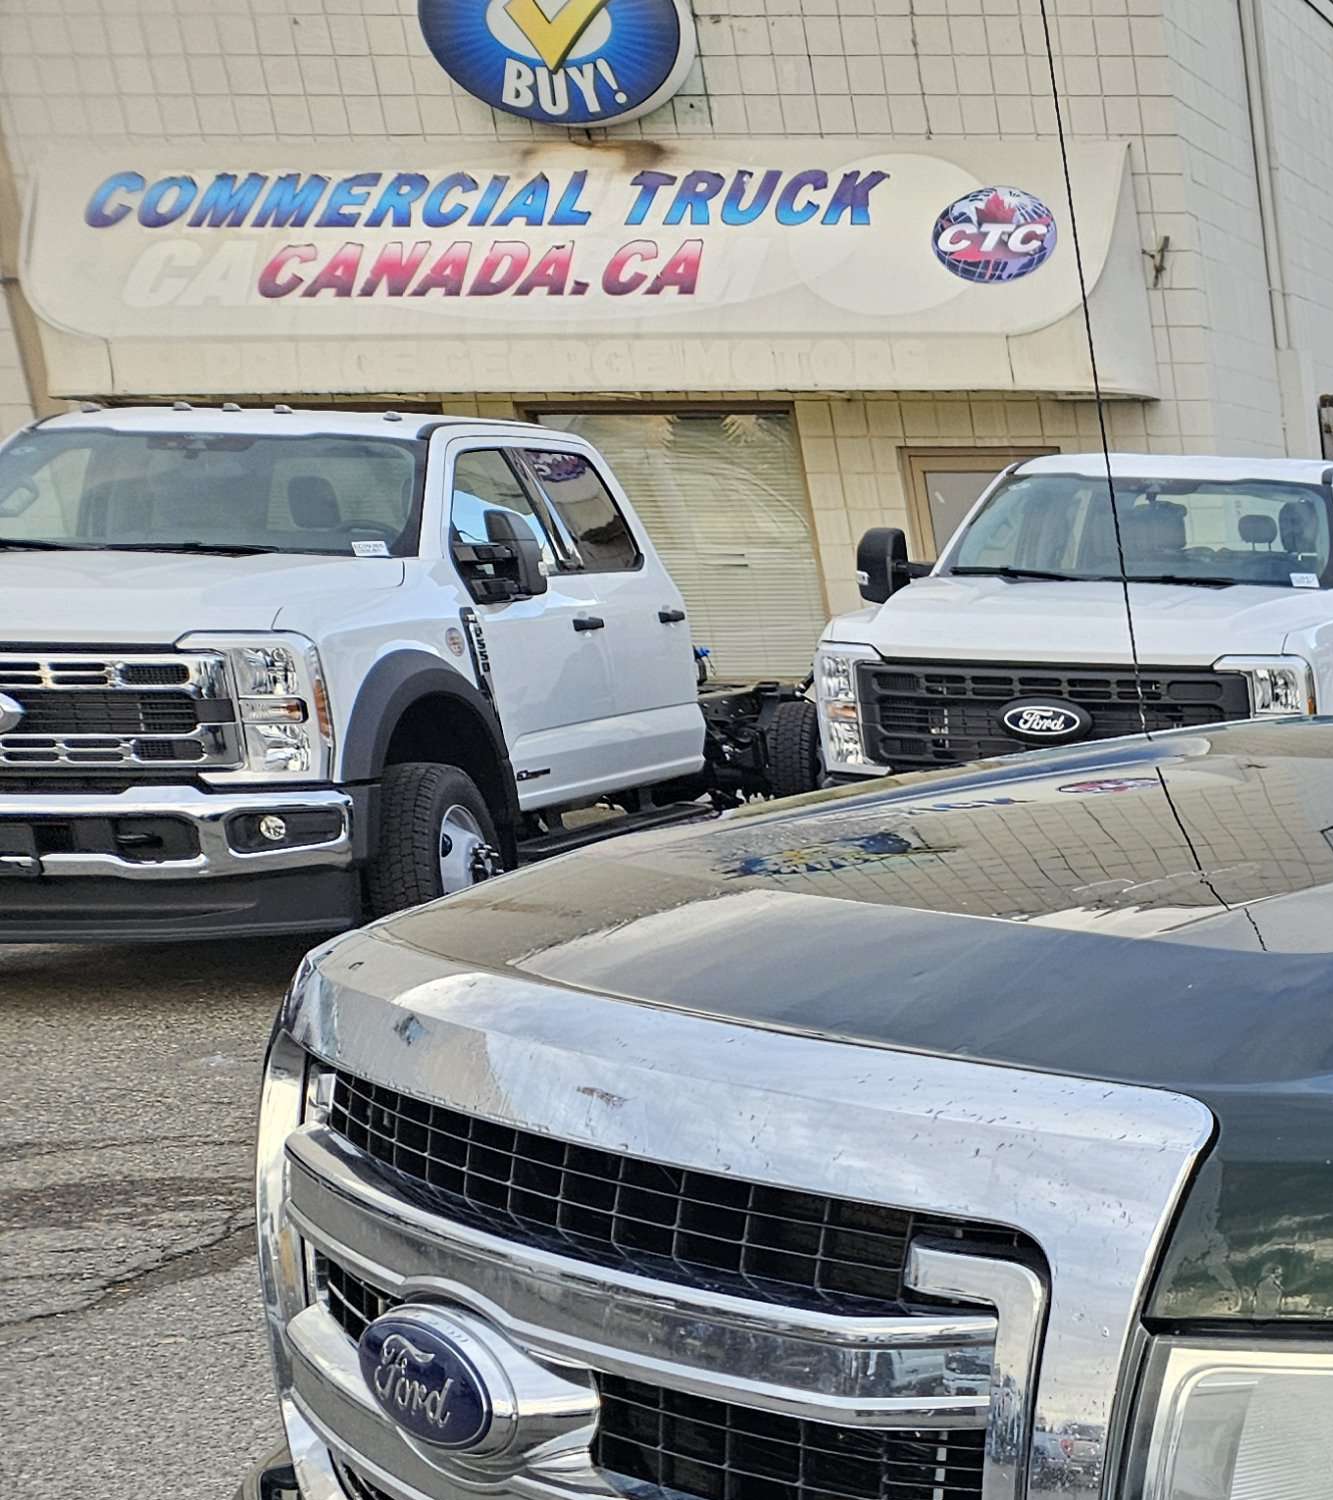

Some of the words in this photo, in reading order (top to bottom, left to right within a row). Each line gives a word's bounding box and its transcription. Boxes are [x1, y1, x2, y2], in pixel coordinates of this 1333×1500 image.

[502, 57, 628, 116] BUY!
[84, 169, 592, 230] COMMERCIAL
[623, 169, 891, 226] TRUCK
[937, 222, 1048, 253] CTC
[257, 238, 704, 300] CANADA.CA
[1018, 709, 1065, 731] Ford
[374, 1334, 454, 1428] Ford
